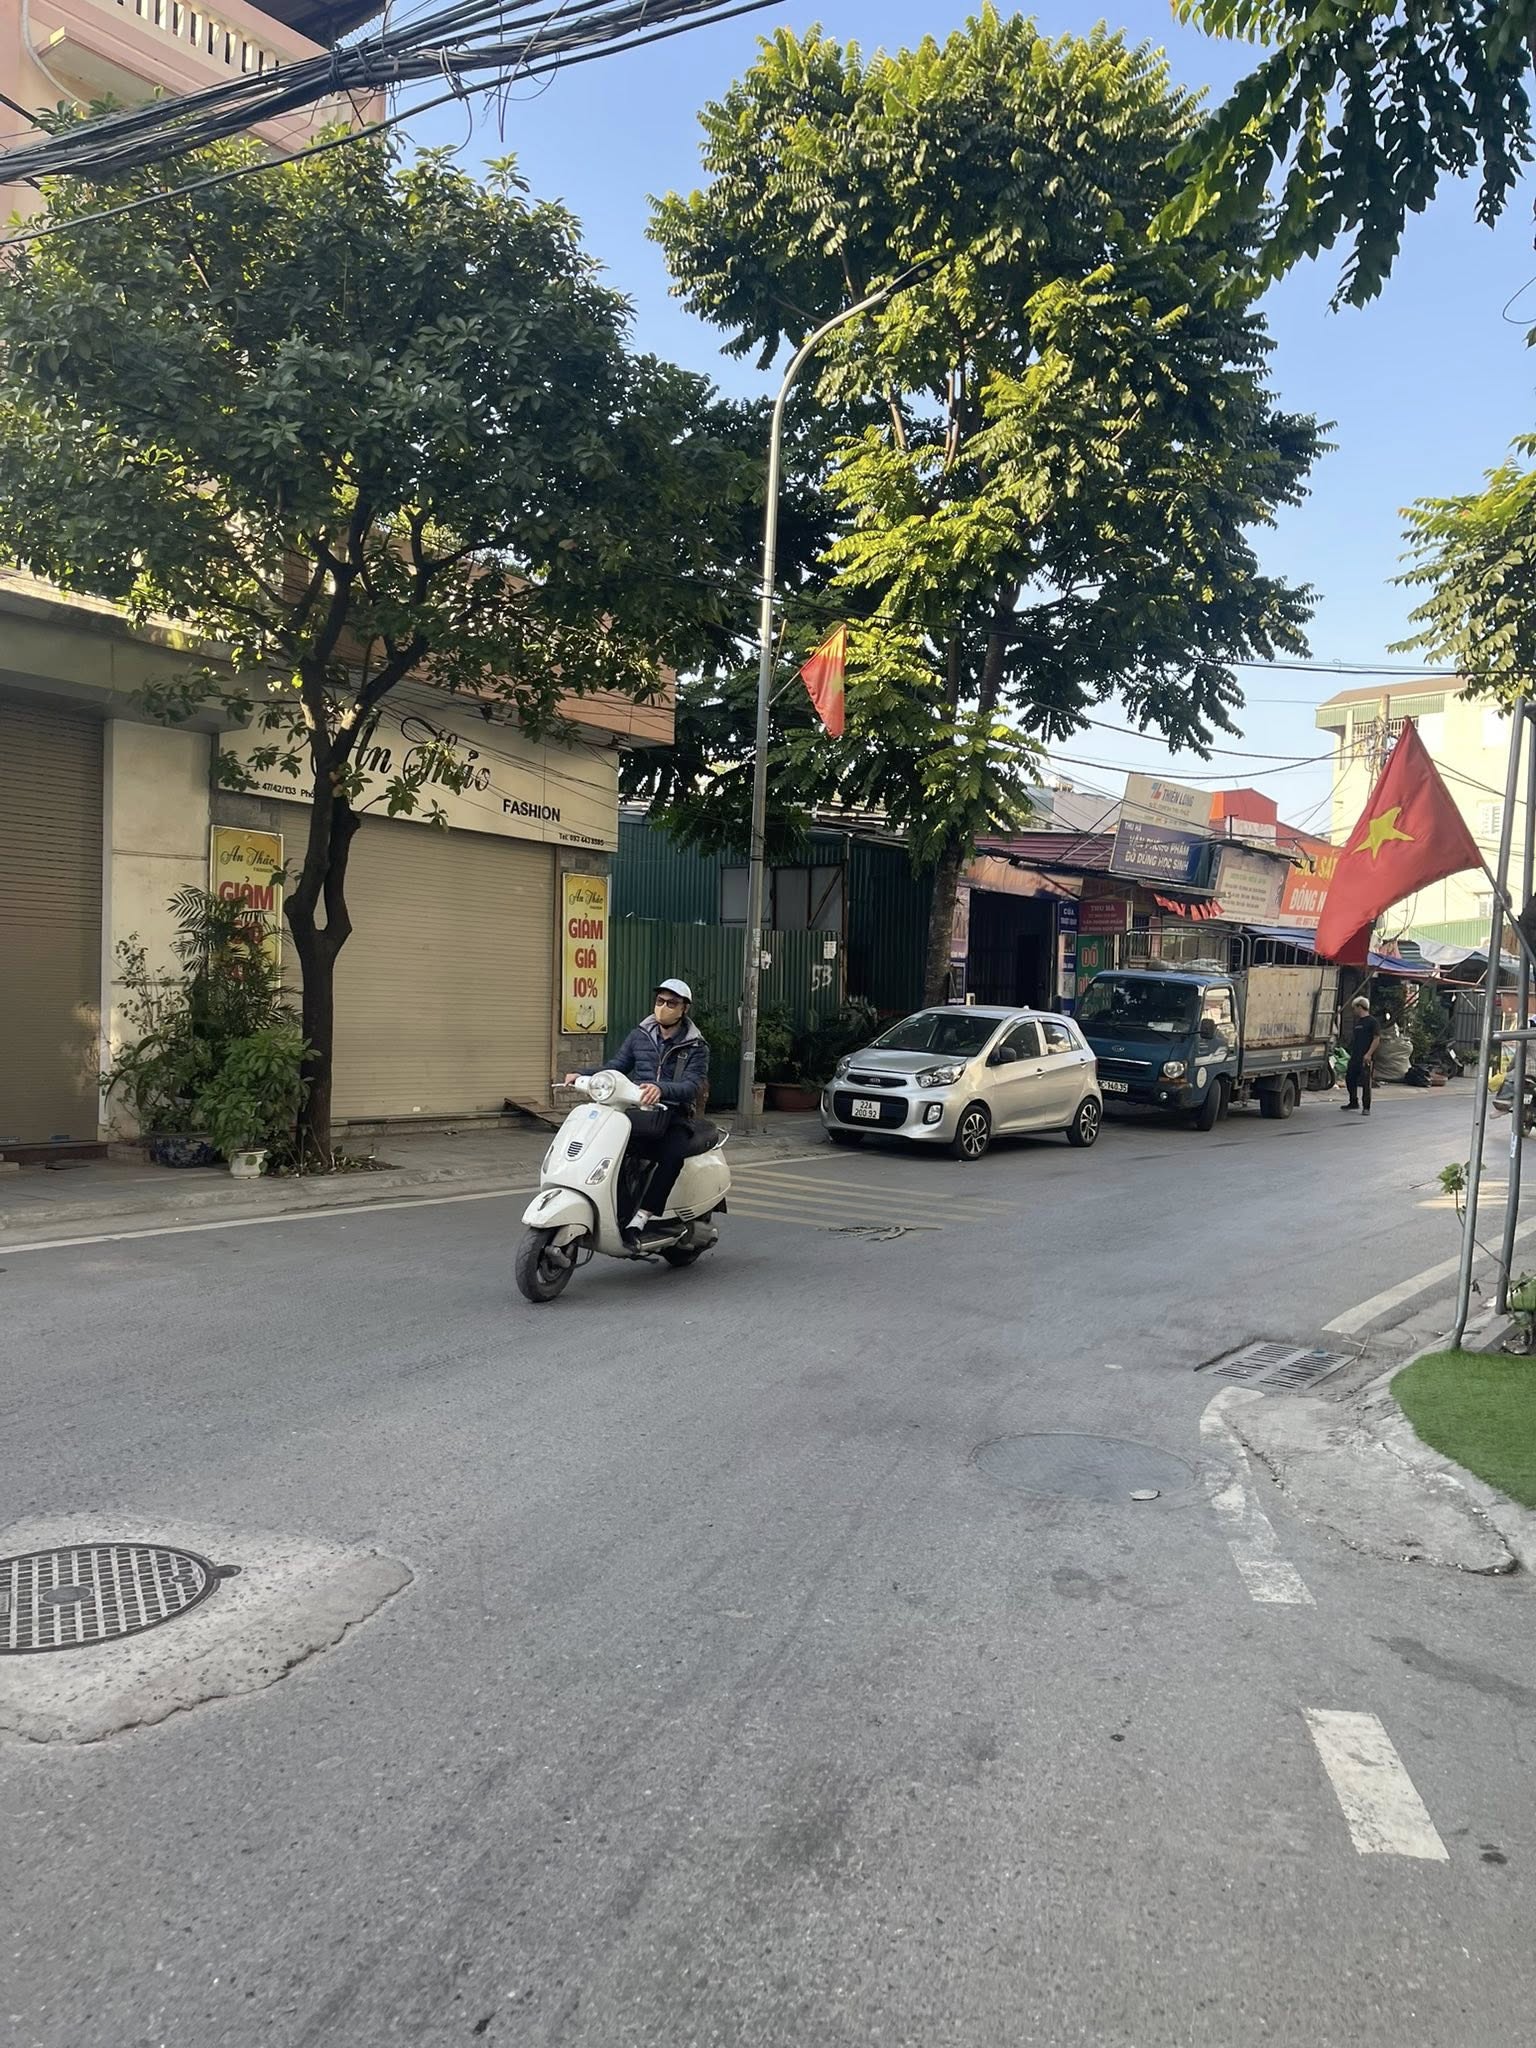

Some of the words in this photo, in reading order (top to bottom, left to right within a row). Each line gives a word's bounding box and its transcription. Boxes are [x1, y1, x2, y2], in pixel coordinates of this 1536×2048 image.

[502, 799, 561, 823] FASHION
[219, 845, 244, 866] An
[218, 875, 274, 911] GIẢM
[568, 888, 584, 906] An
[568, 912, 604, 940] GIẢM
[574, 944, 598, 969] GIÁ
[573, 977, 598, 999] 10%
[860, 1101, 873, 1110] 22A
